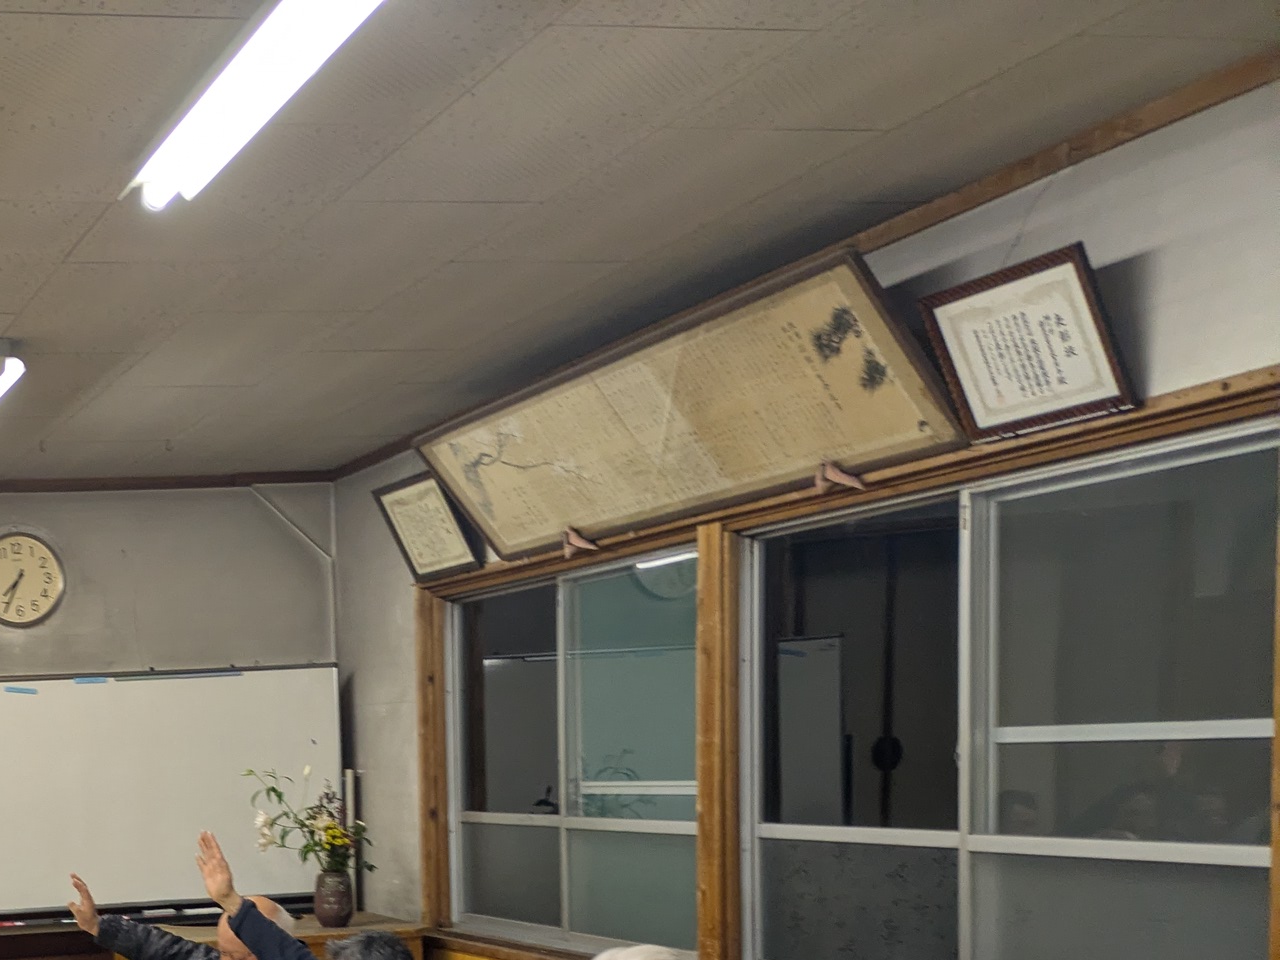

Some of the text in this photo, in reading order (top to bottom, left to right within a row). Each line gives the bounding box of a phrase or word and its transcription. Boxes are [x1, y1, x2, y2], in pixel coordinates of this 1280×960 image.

[10, 542, 23, 554] 12
[28, 545, 35, 557] 1
[38, 556, 48, 569] 2
[43, 571, 53, 584] 3
[40, 588, 49, 598] 4
[15, 604, 25, 617] 6
